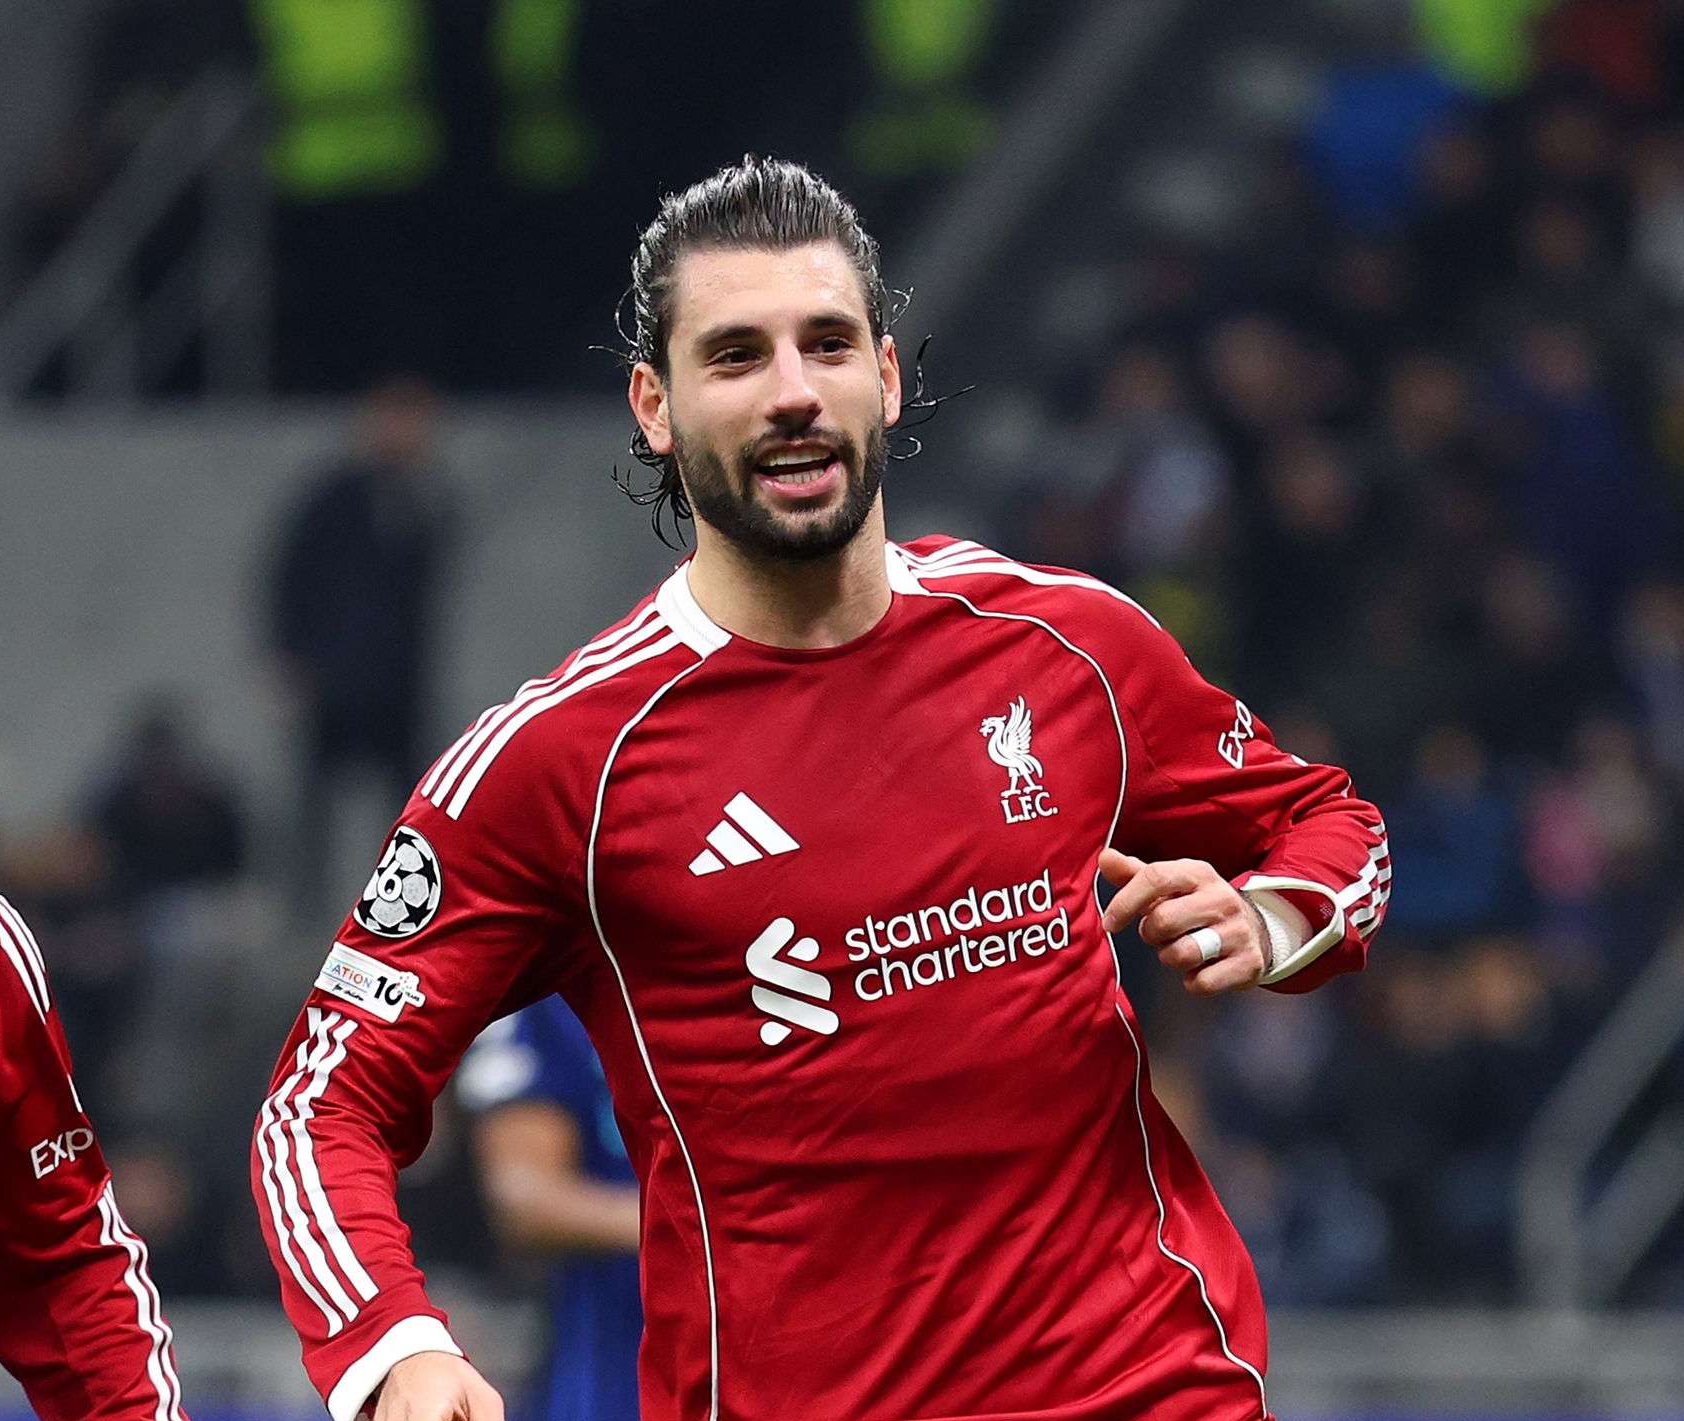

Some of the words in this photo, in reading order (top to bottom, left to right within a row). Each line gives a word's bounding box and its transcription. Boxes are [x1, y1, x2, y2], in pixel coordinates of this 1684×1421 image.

[1217, 699, 1255, 770] Exp
[1000, 791, 1059, 825] L.F.C.
[376, 859, 403, 903] 6
[844, 868, 1053, 962] standard
[854, 906, 1070, 1001] chartered
[29, 1127, 94, 1180] Exp
